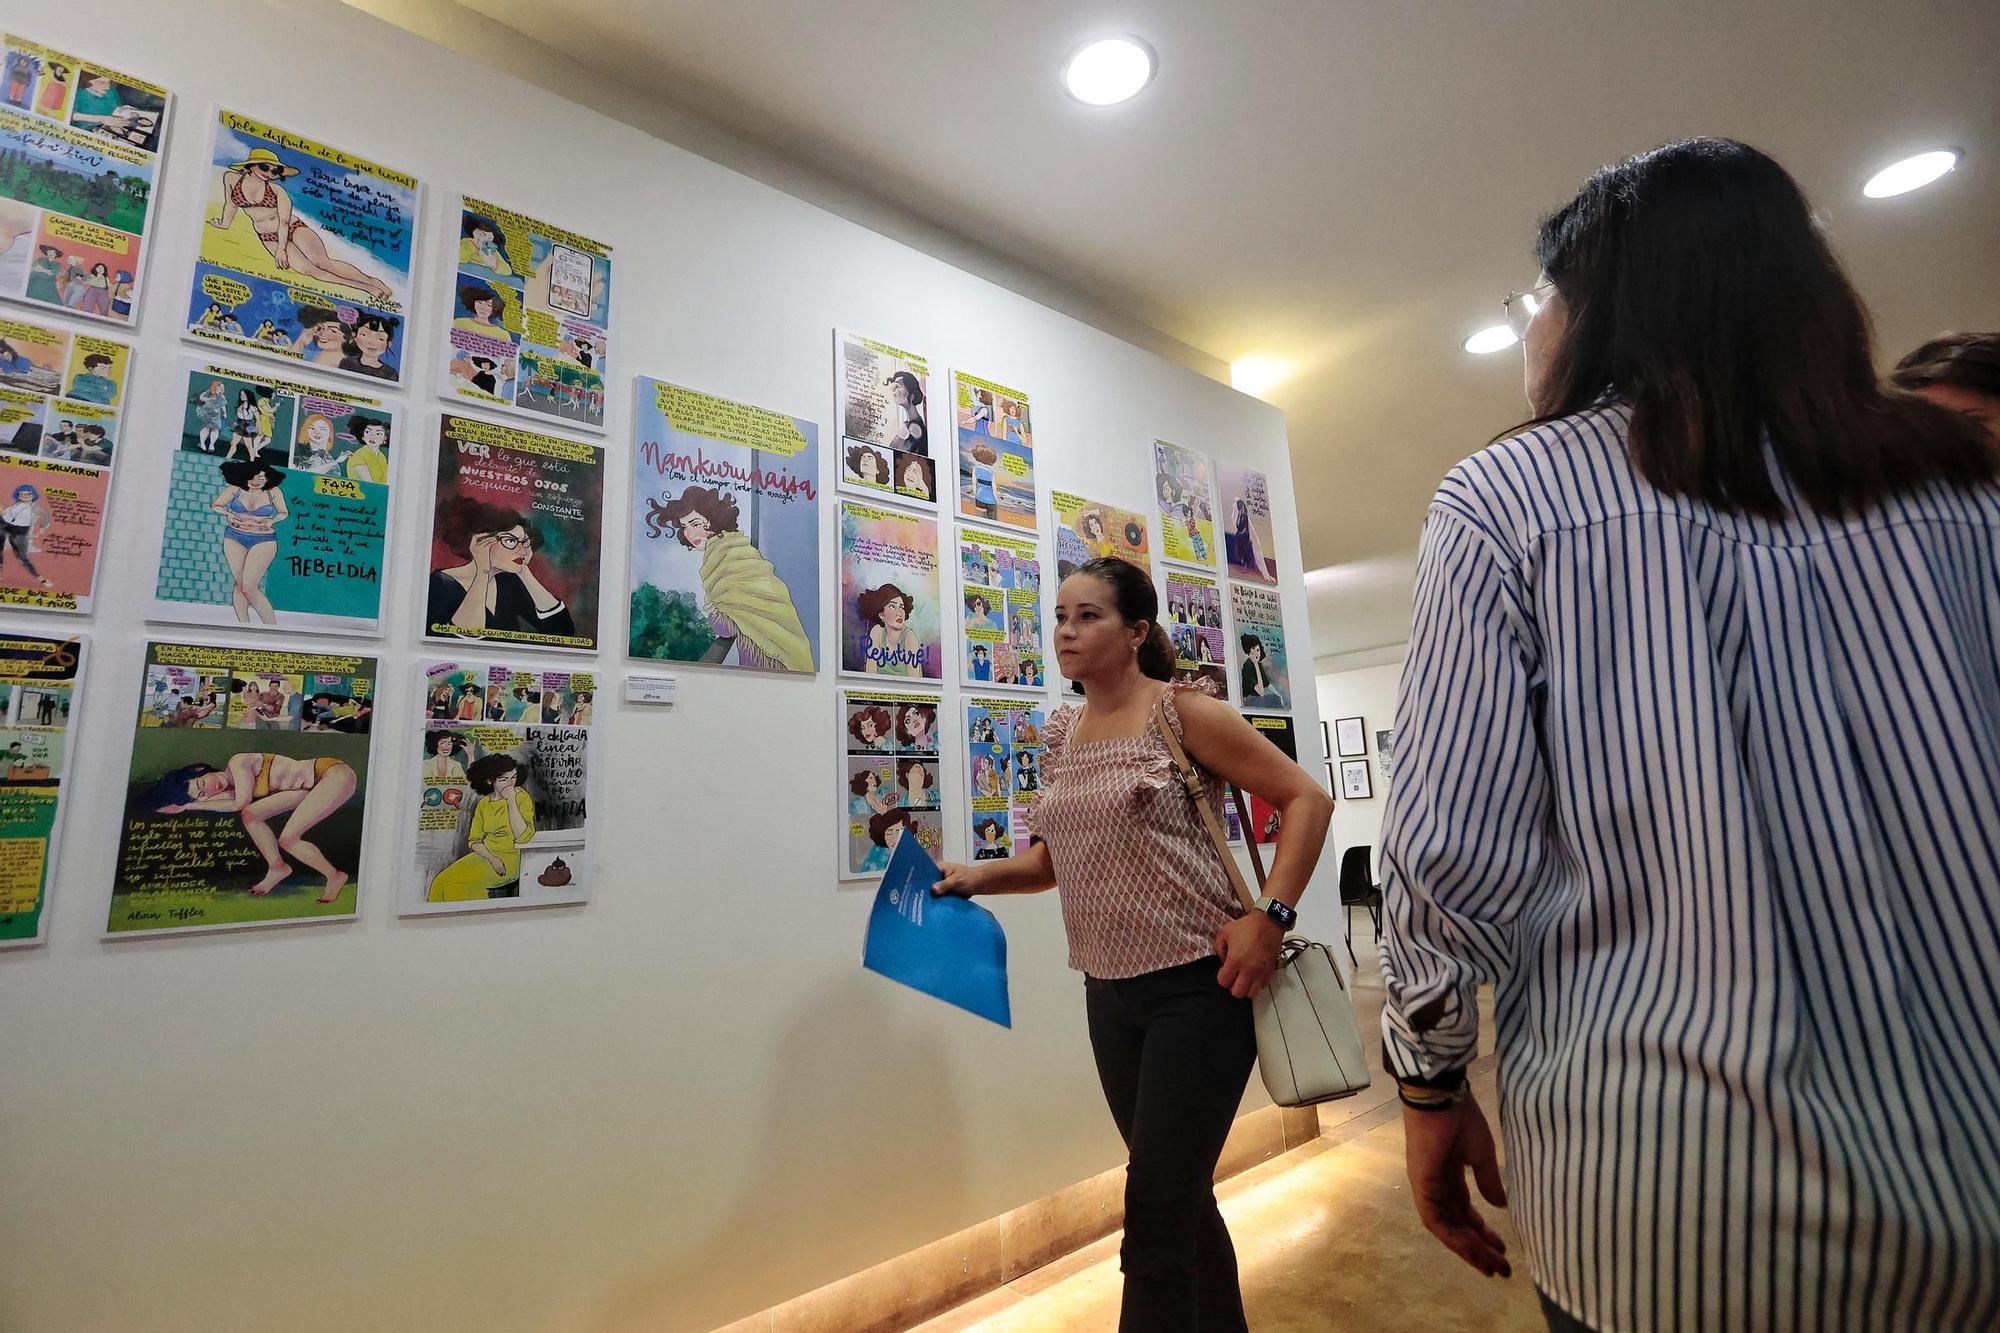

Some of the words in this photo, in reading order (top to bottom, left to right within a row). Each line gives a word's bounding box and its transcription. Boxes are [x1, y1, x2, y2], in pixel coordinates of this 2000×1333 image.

[262, 128, 311, 151] disfruta
[317, 146, 332, 158] de
[353, 162, 373, 176] que
[657, 384, 672, 392] NOS
[717, 397, 735, 407] CASA
[470, 422, 501, 433] NOTICIAS
[456, 440, 491, 459] VER
[497, 449, 510, 461] lo
[515, 455, 536, 468] que
[542, 459, 570, 473] está
[19, 459, 39, 468] NOS
[45, 463, 100, 479] SALVARON
[459, 466, 529, 484] NUESTROS
[534, 479, 569, 492] OJOS
[690, 473, 699, 484] el
[285, 555, 377, 584] REBELDÍA
[477, 629, 513, 639] SEGUIMOS
[529, 634, 566, 644] NUESTRAS
